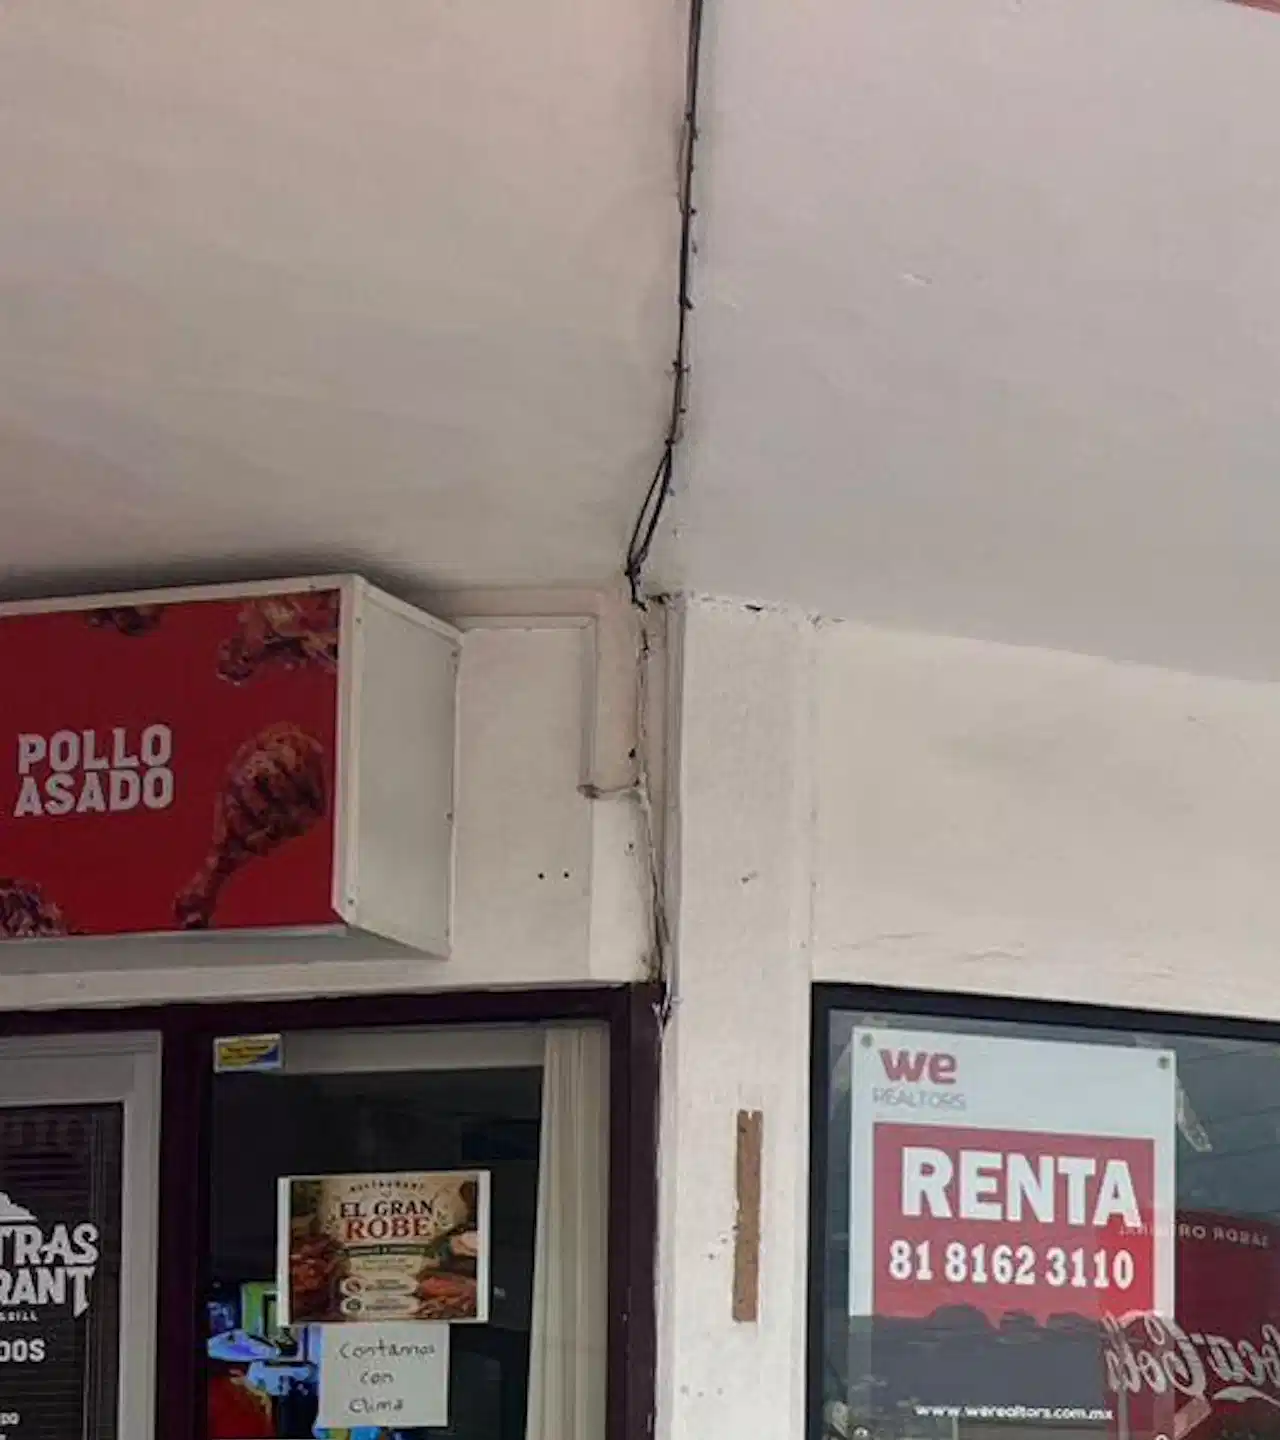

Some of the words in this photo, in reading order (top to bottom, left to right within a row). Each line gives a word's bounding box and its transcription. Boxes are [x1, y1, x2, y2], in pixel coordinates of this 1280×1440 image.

[18, 723, 173, 775] POLLO
[13, 767, 174, 818] ASADO
[879, 1048, 958, 1085] we
[872, 1087, 968, 1111] REALTORS
[902, 1146, 1142, 1228] RENTA
[339, 1202, 366, 1218] EL
[374, 1199, 433, 1217] GRAN
[346, 1216, 432, 1240] ROBE
[888, 1240, 933, 1280] 81
[945, 1242, 1036, 1284] 8162
[1044, 1247, 1134, 1289] 3110
[915, 1404, 1113, 1420] www.werealtors.com.mx
